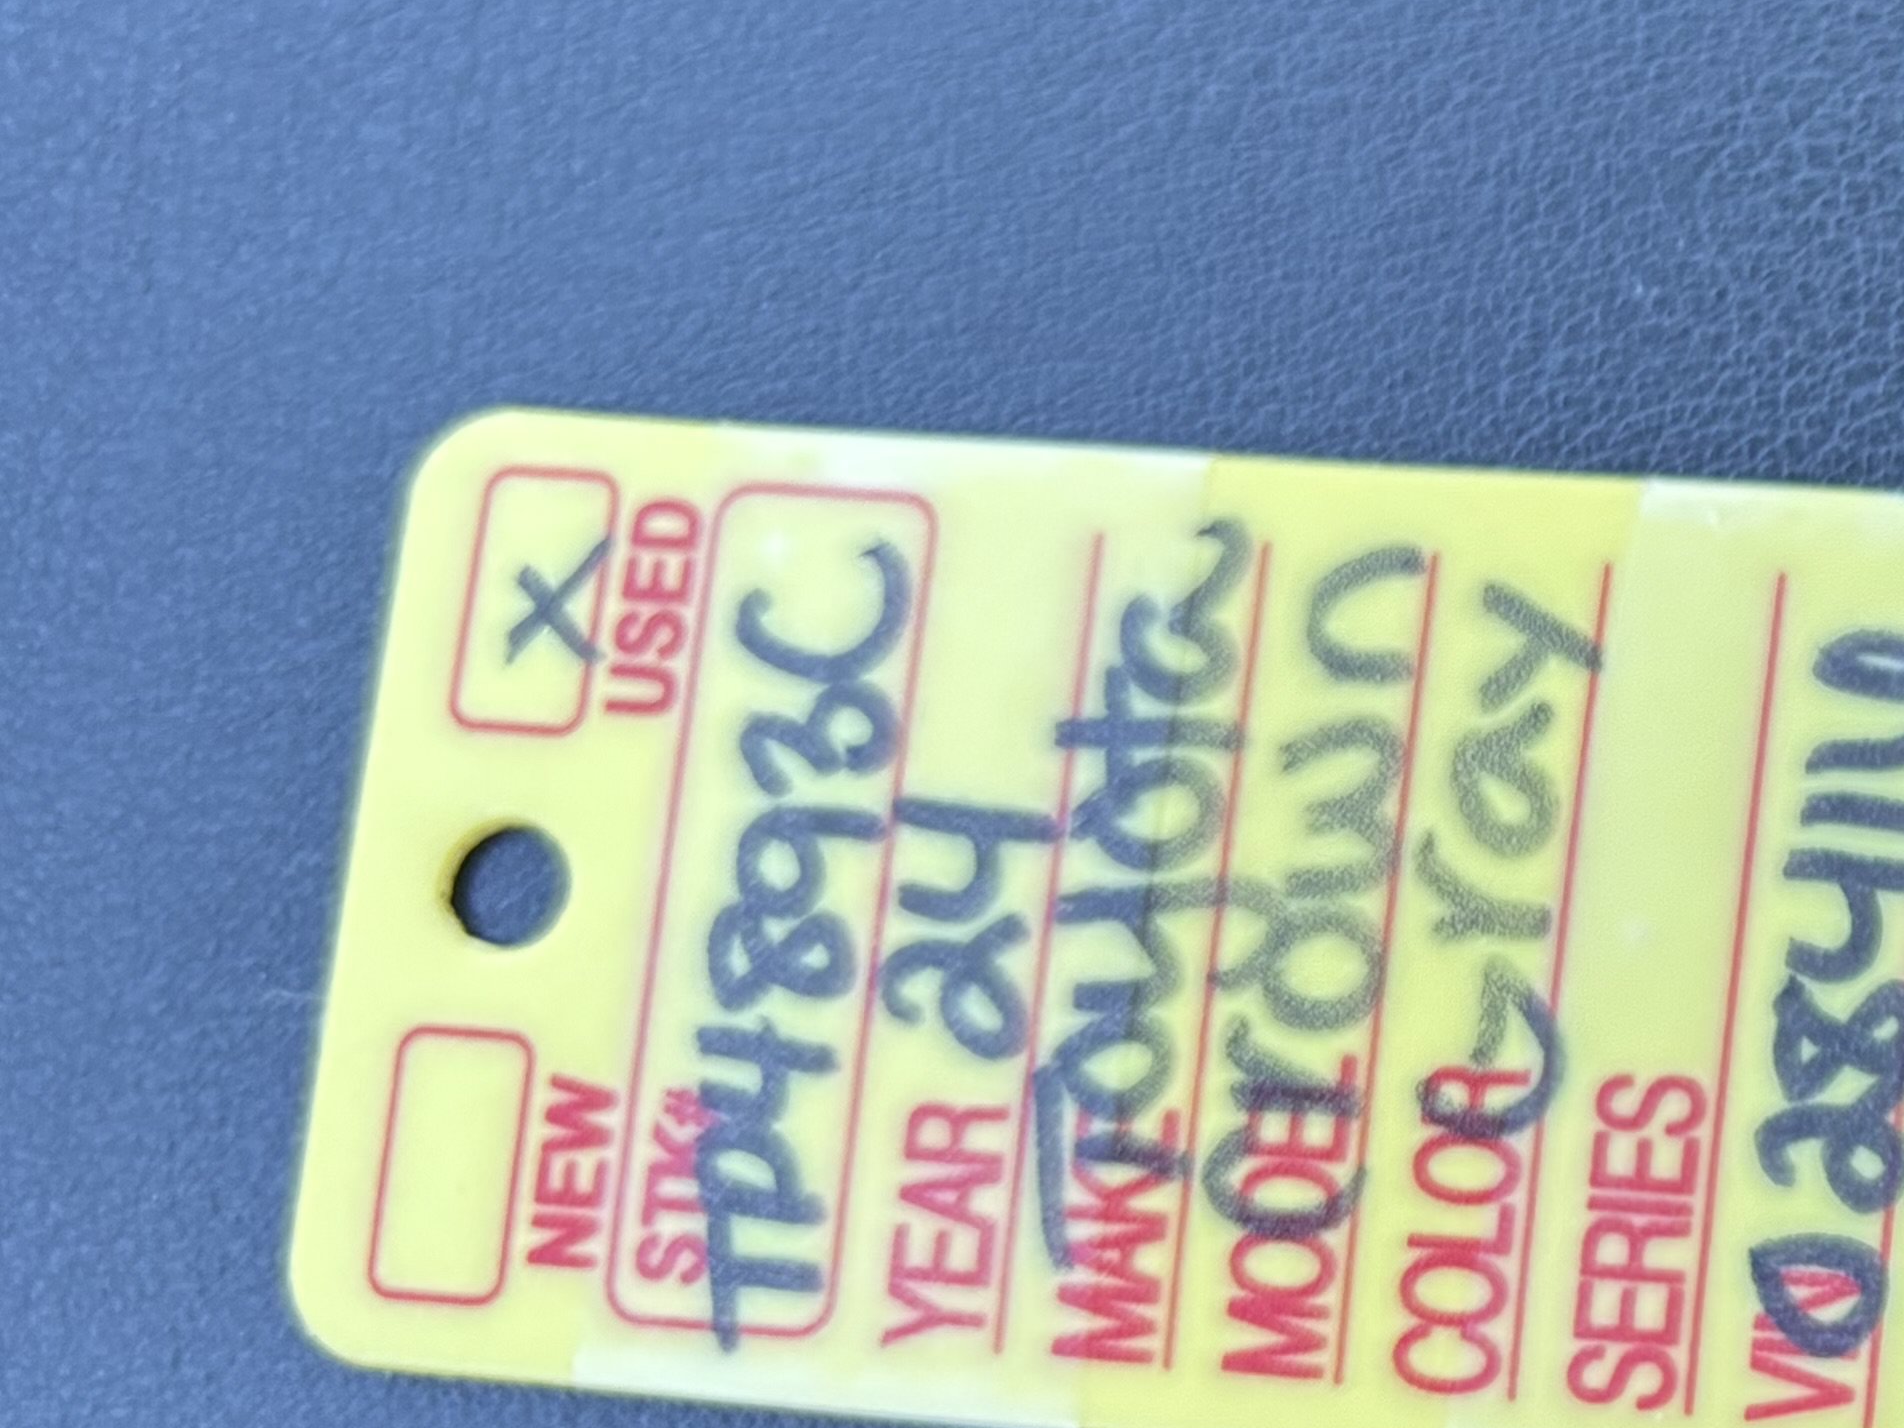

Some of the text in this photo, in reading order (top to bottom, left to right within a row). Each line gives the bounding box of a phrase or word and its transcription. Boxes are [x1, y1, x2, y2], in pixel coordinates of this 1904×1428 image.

[603, 497, 702, 716] USED
[874, 796, 1061, 1061] 24
[1033, 518, 1290, 1271] Toyota
[526, 1074, 620, 1270] NEW
[634, 1086, 719, 1285] STK#
[880, 1098, 1012, 1348] YEAR
[1050, 1109, 1182, 1363] MAKE
[1221, 1054, 1358, 1379] MODEL
[1392, 1065, 1532, 1398] COLOR
[1566, 1073, 1709, 1413] SERIES
